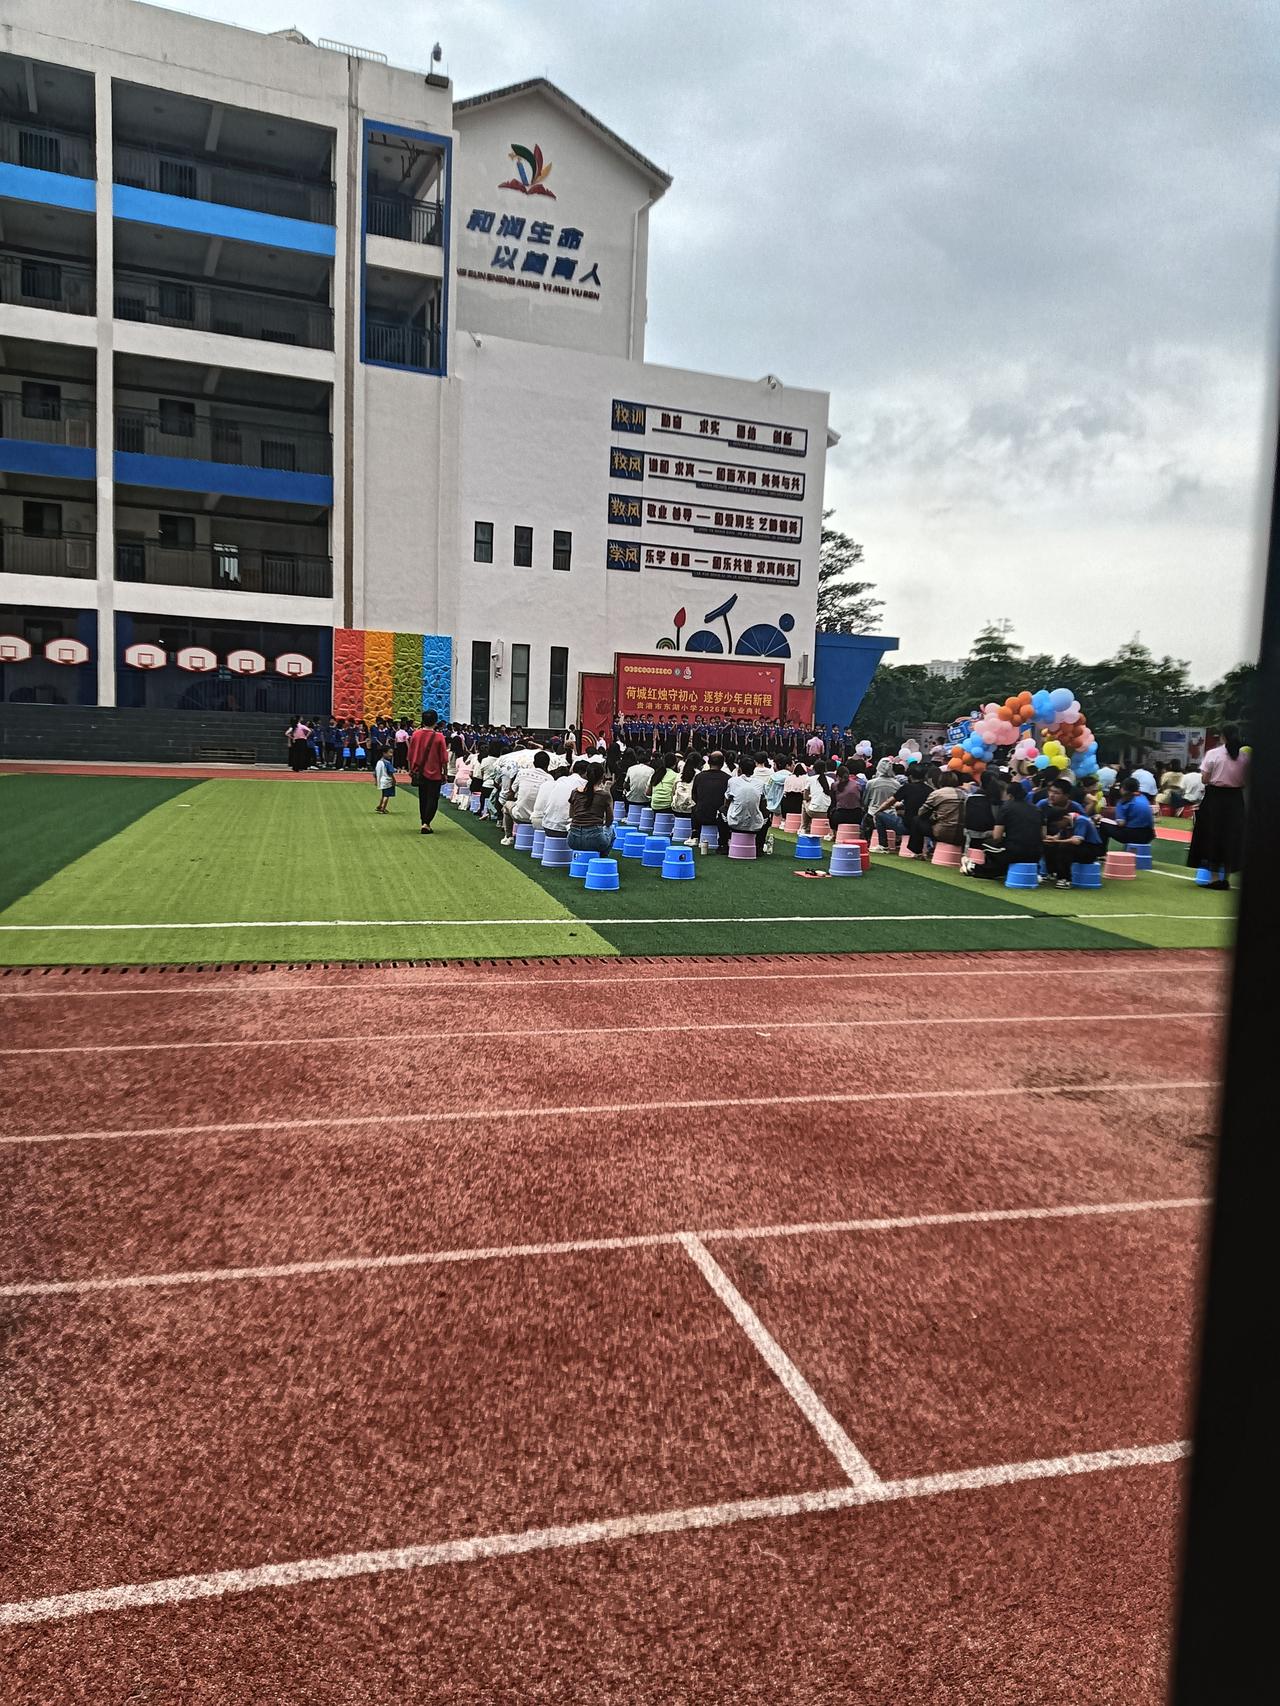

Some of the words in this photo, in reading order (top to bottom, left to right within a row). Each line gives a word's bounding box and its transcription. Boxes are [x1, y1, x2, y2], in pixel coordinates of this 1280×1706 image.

[466, 208, 584, 250] 和润生命
[614, 402, 644, 428] 校训
[612, 449, 641, 473] 校风
[610, 496, 640, 519] 教风
[609, 542, 638, 564] 学风
[645, 549, 666, 565] 乐学
[626, 686, 699, 704] 荷城红烛守初心
[703, 690, 773, 707] 逐梦少年启新程
